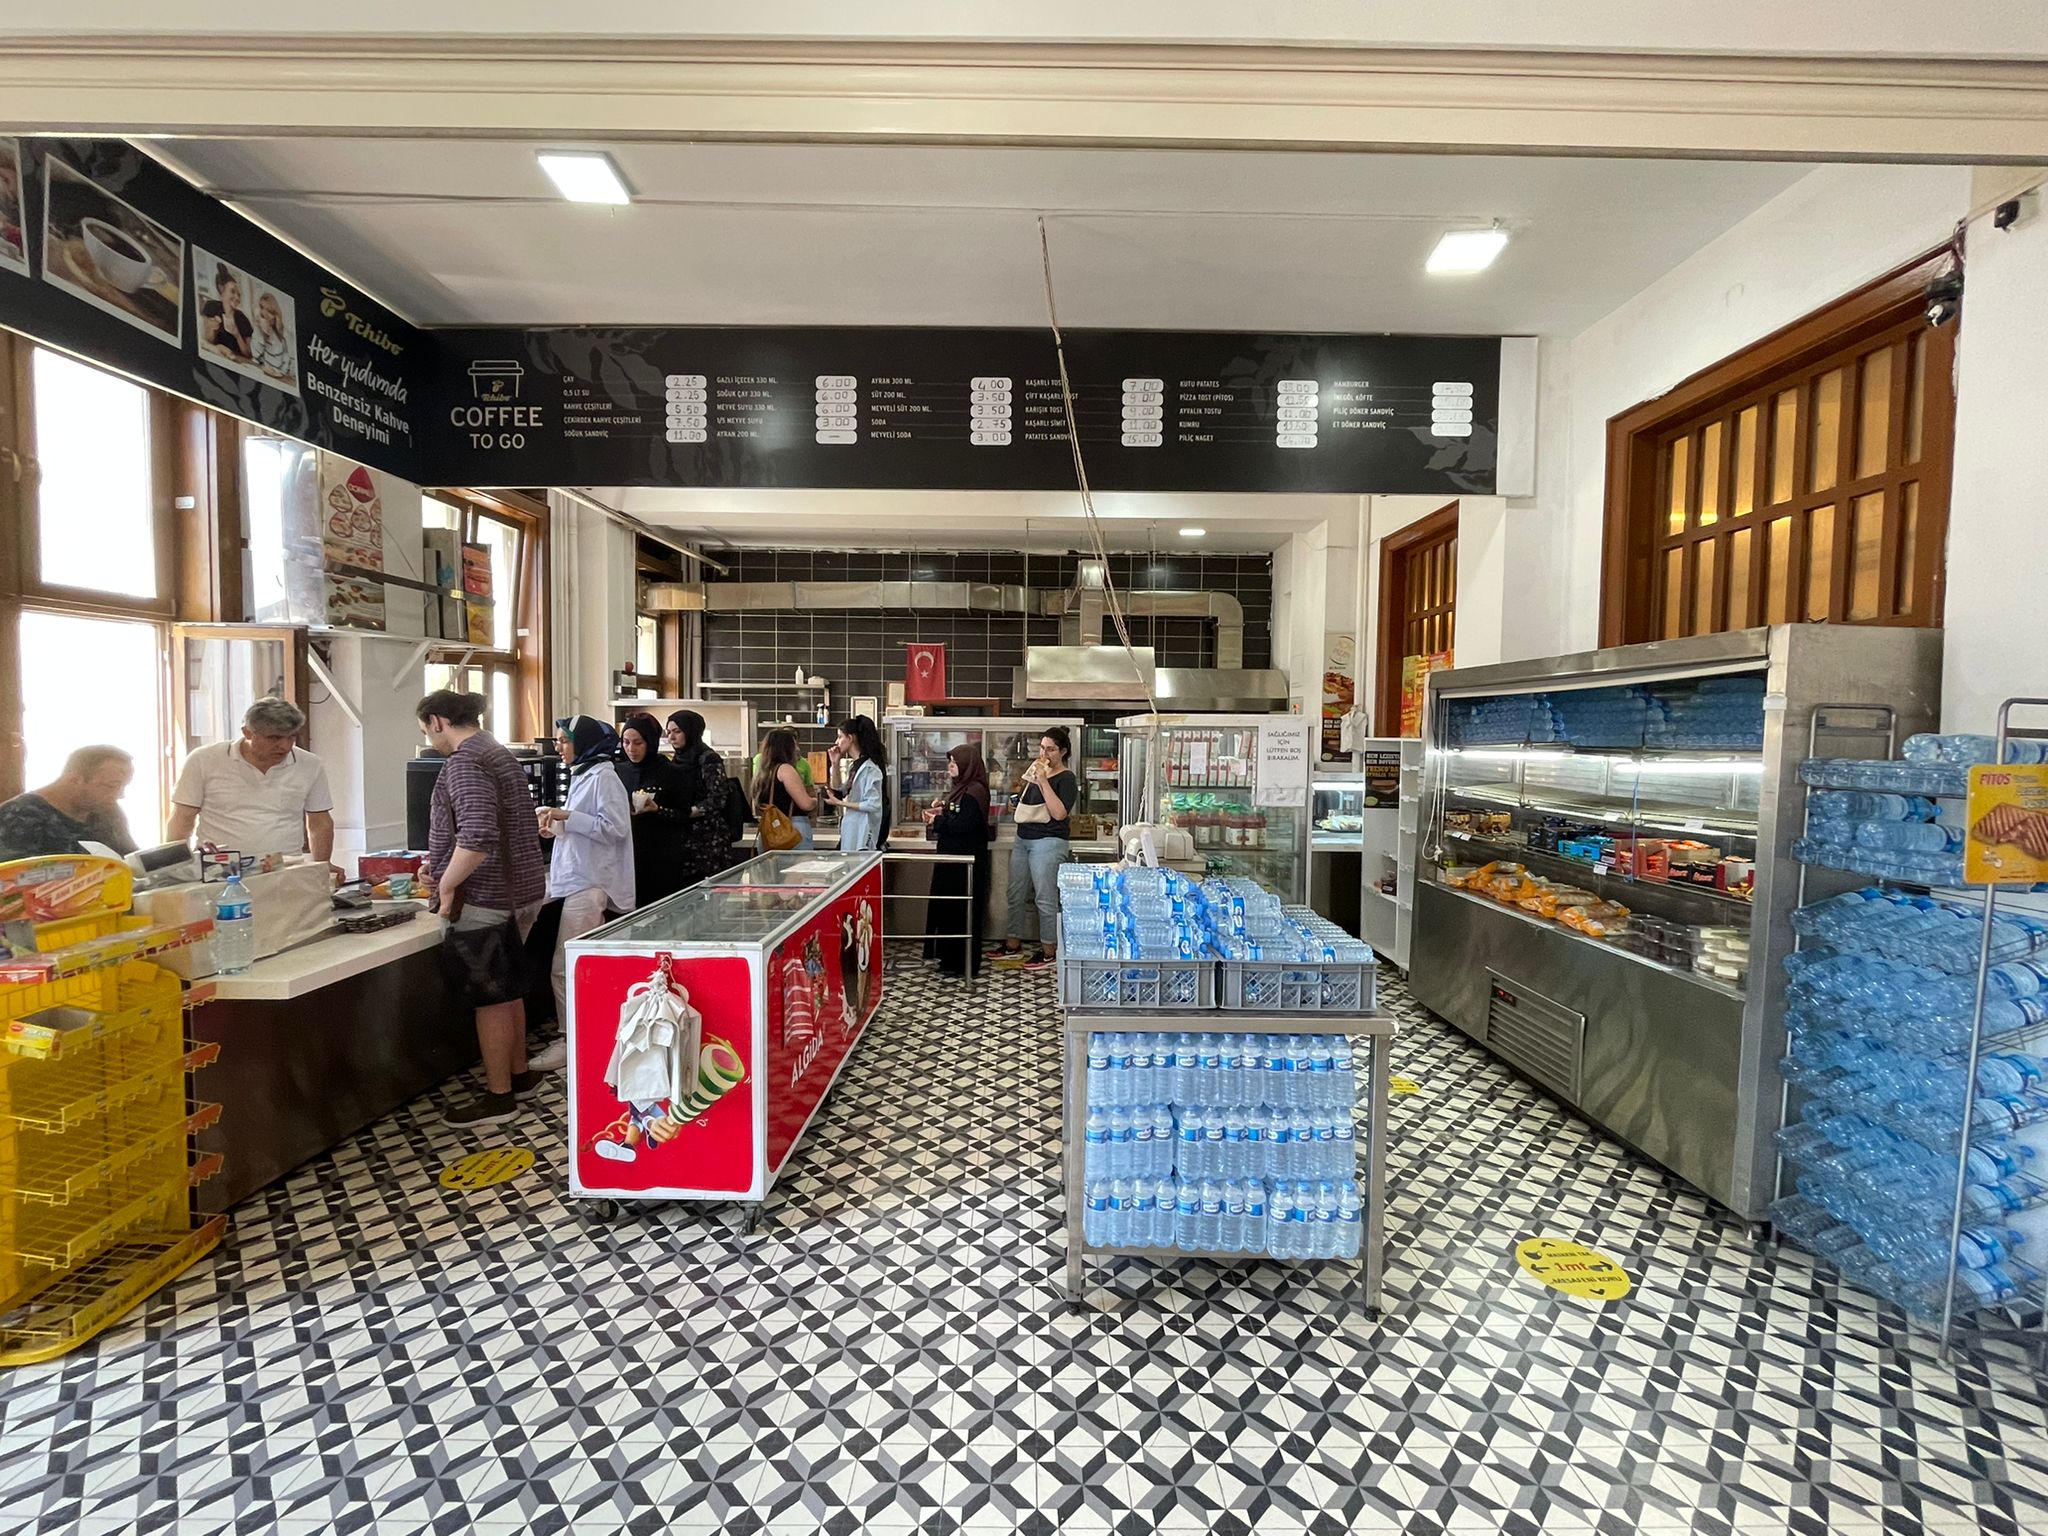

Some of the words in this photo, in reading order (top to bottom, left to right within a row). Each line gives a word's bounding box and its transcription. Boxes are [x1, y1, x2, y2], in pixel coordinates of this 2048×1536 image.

[345, 312, 403, 355] Tchibo
[307, 333, 339, 366] Her
[341, 355, 408, 404] yudumda
[673, 376, 698, 387] 2.25
[716, 376, 733, 384] GAZLI
[756, 376, 767, 384] 330
[822, 378, 851, 388] 6.00
[1025, 379, 1050, 387] KAŞARLI
[1130, 381, 1159, 392] 7.00
[675, 390, 700, 400] 2.25
[716, 389, 736, 398] SOĞUK
[737, 390, 749, 399] ÇAY
[750, 390, 761, 398] 330
[821, 391, 849, 401] 6.00
[871, 390, 883, 398] SÜT
[977, 392, 1005, 402] 3.50
[307, 371, 371, 417] Benzersiz
[374, 404, 410, 434] Kahve
[675, 405, 699, 415] 5.50
[821, 404, 850, 414] 6.00
[871, 404, 896, 412] MEYVELİ
[897, 404, 908, 412] SÜT
[1025, 406, 1048, 414] KARIŞIK
[1370, 408, 1394, 416] SANDVİÇ
[450, 406, 544, 427] COFFEE
[333, 405, 390, 445] Deneyimi
[823, 418, 850, 427] 3.00
[871, 418, 886, 426] SODA
[977, 419, 1006, 429] 2.75
[1025, 420, 1049, 428] KAŞARLI
[1361, 421, 1387, 430] SANDVİÇ
[673, 430, 701, 440] 11.00
[977, 433, 1006, 442] 3.00
[469, 433, 494, 449] TO
[499, 433, 525, 449] GO
